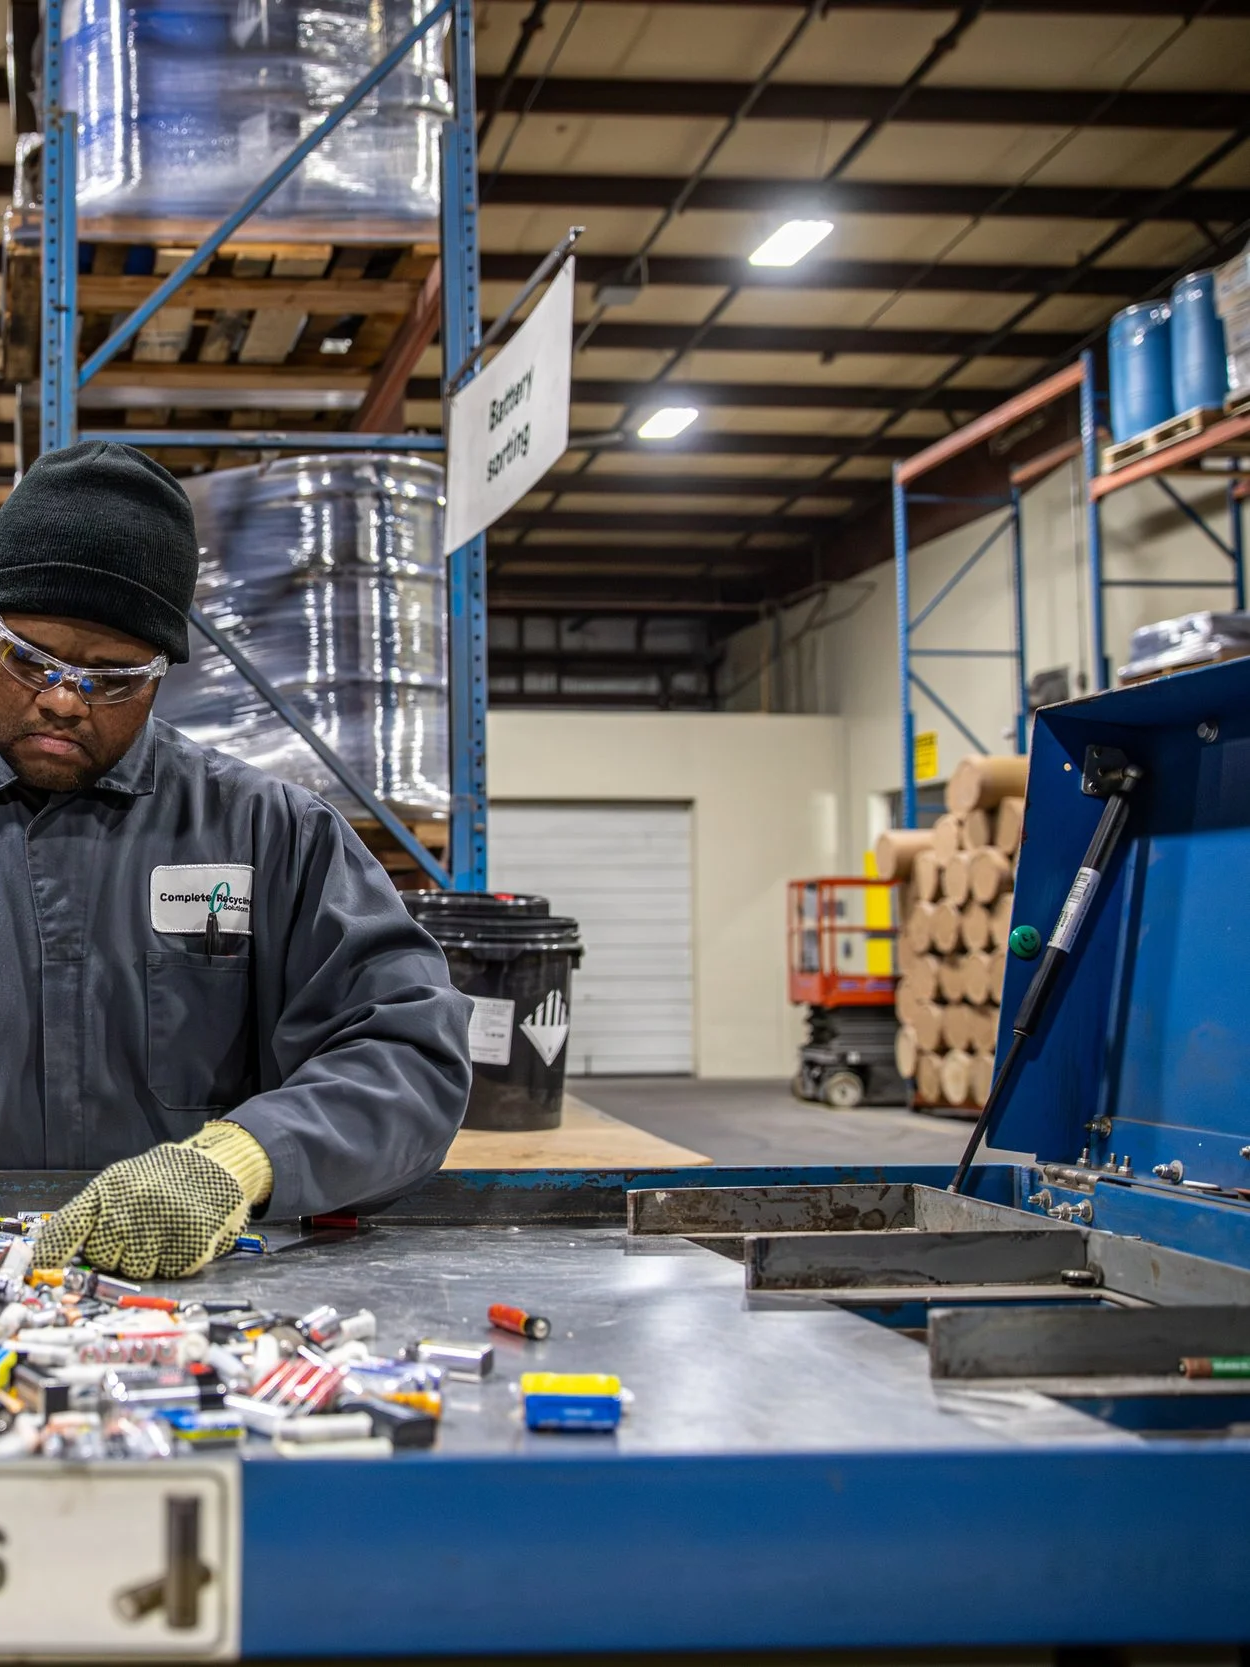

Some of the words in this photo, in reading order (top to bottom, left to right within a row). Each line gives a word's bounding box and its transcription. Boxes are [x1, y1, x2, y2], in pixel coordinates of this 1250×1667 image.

[488, 364, 535, 433] Battery
[486, 421, 530, 482] sorting
[159, 892, 211, 904] Complete
